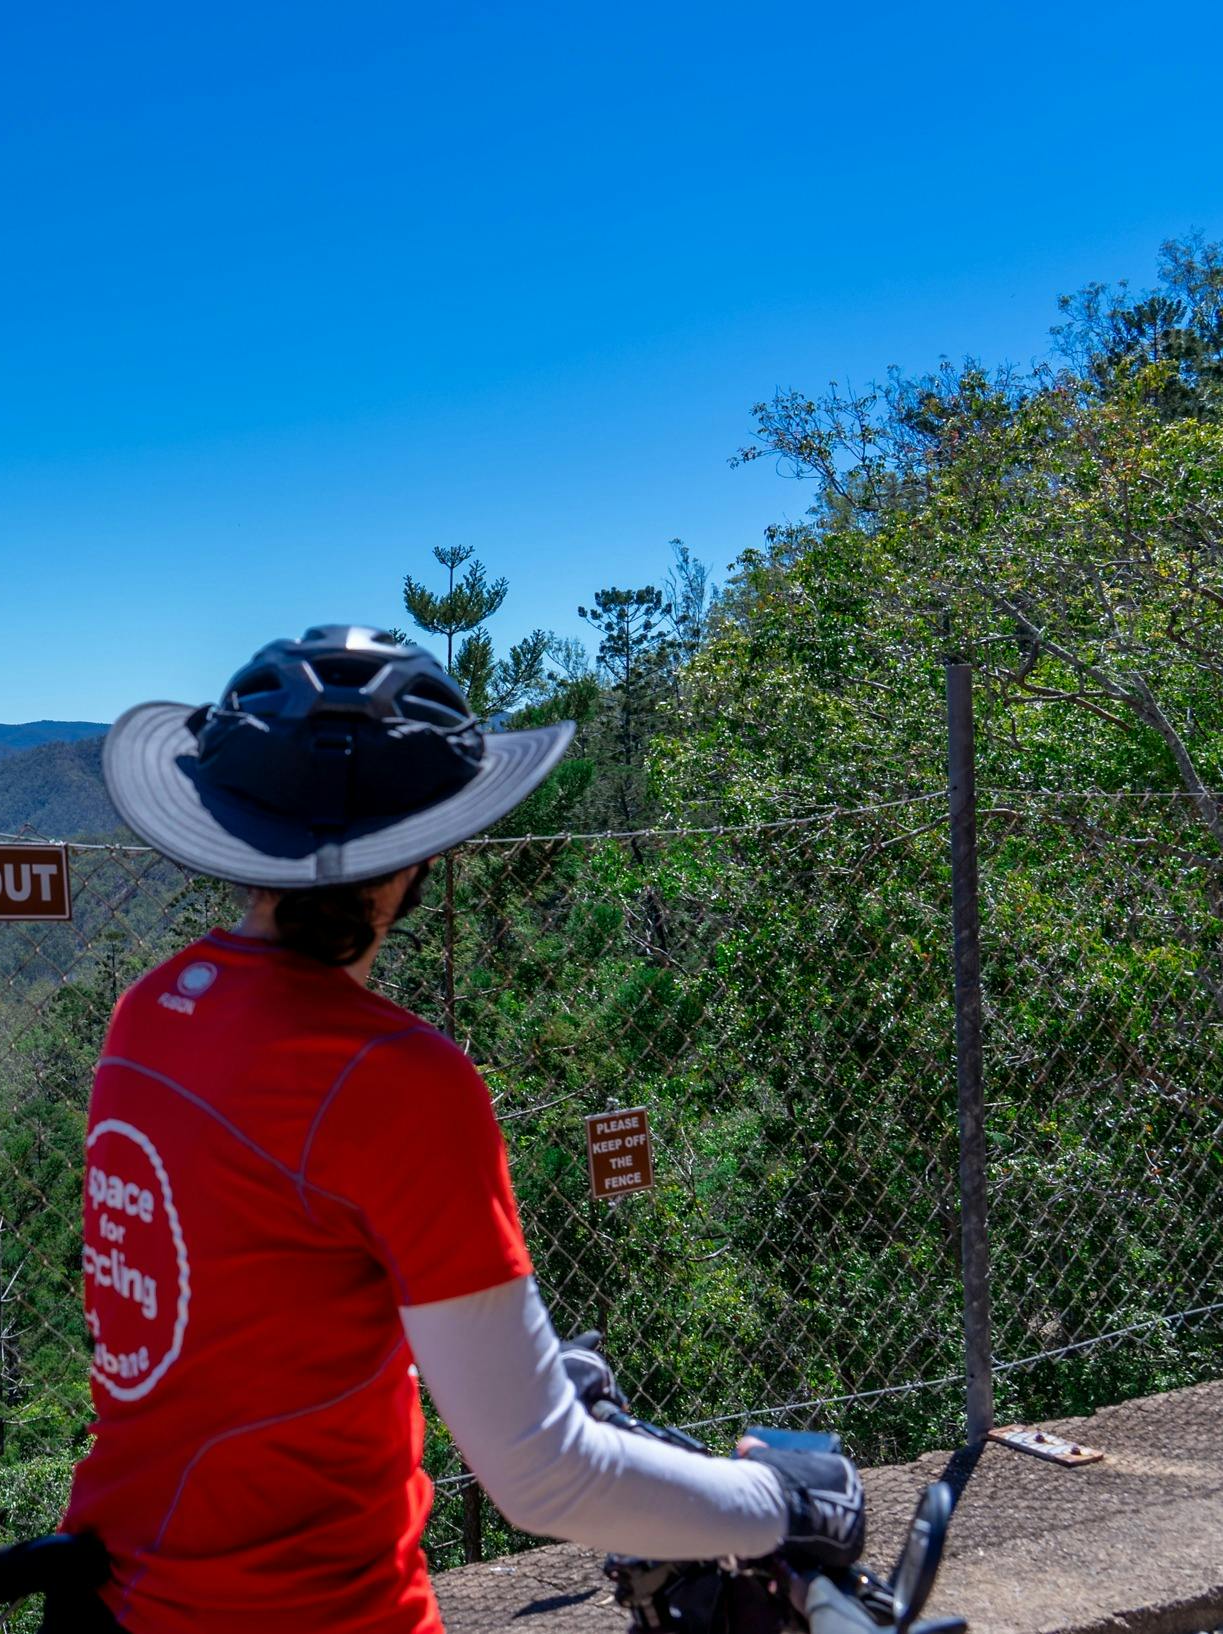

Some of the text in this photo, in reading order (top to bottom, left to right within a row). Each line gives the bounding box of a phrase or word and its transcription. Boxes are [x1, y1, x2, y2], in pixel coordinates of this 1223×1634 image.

[596, 1116, 639, 1135] PLEASE
[592, 1133, 646, 1154] KEEP OFF
[609, 1155, 633, 1170] THE
[604, 1171, 642, 1190] FENCE
[99, 1212, 126, 1245] for
